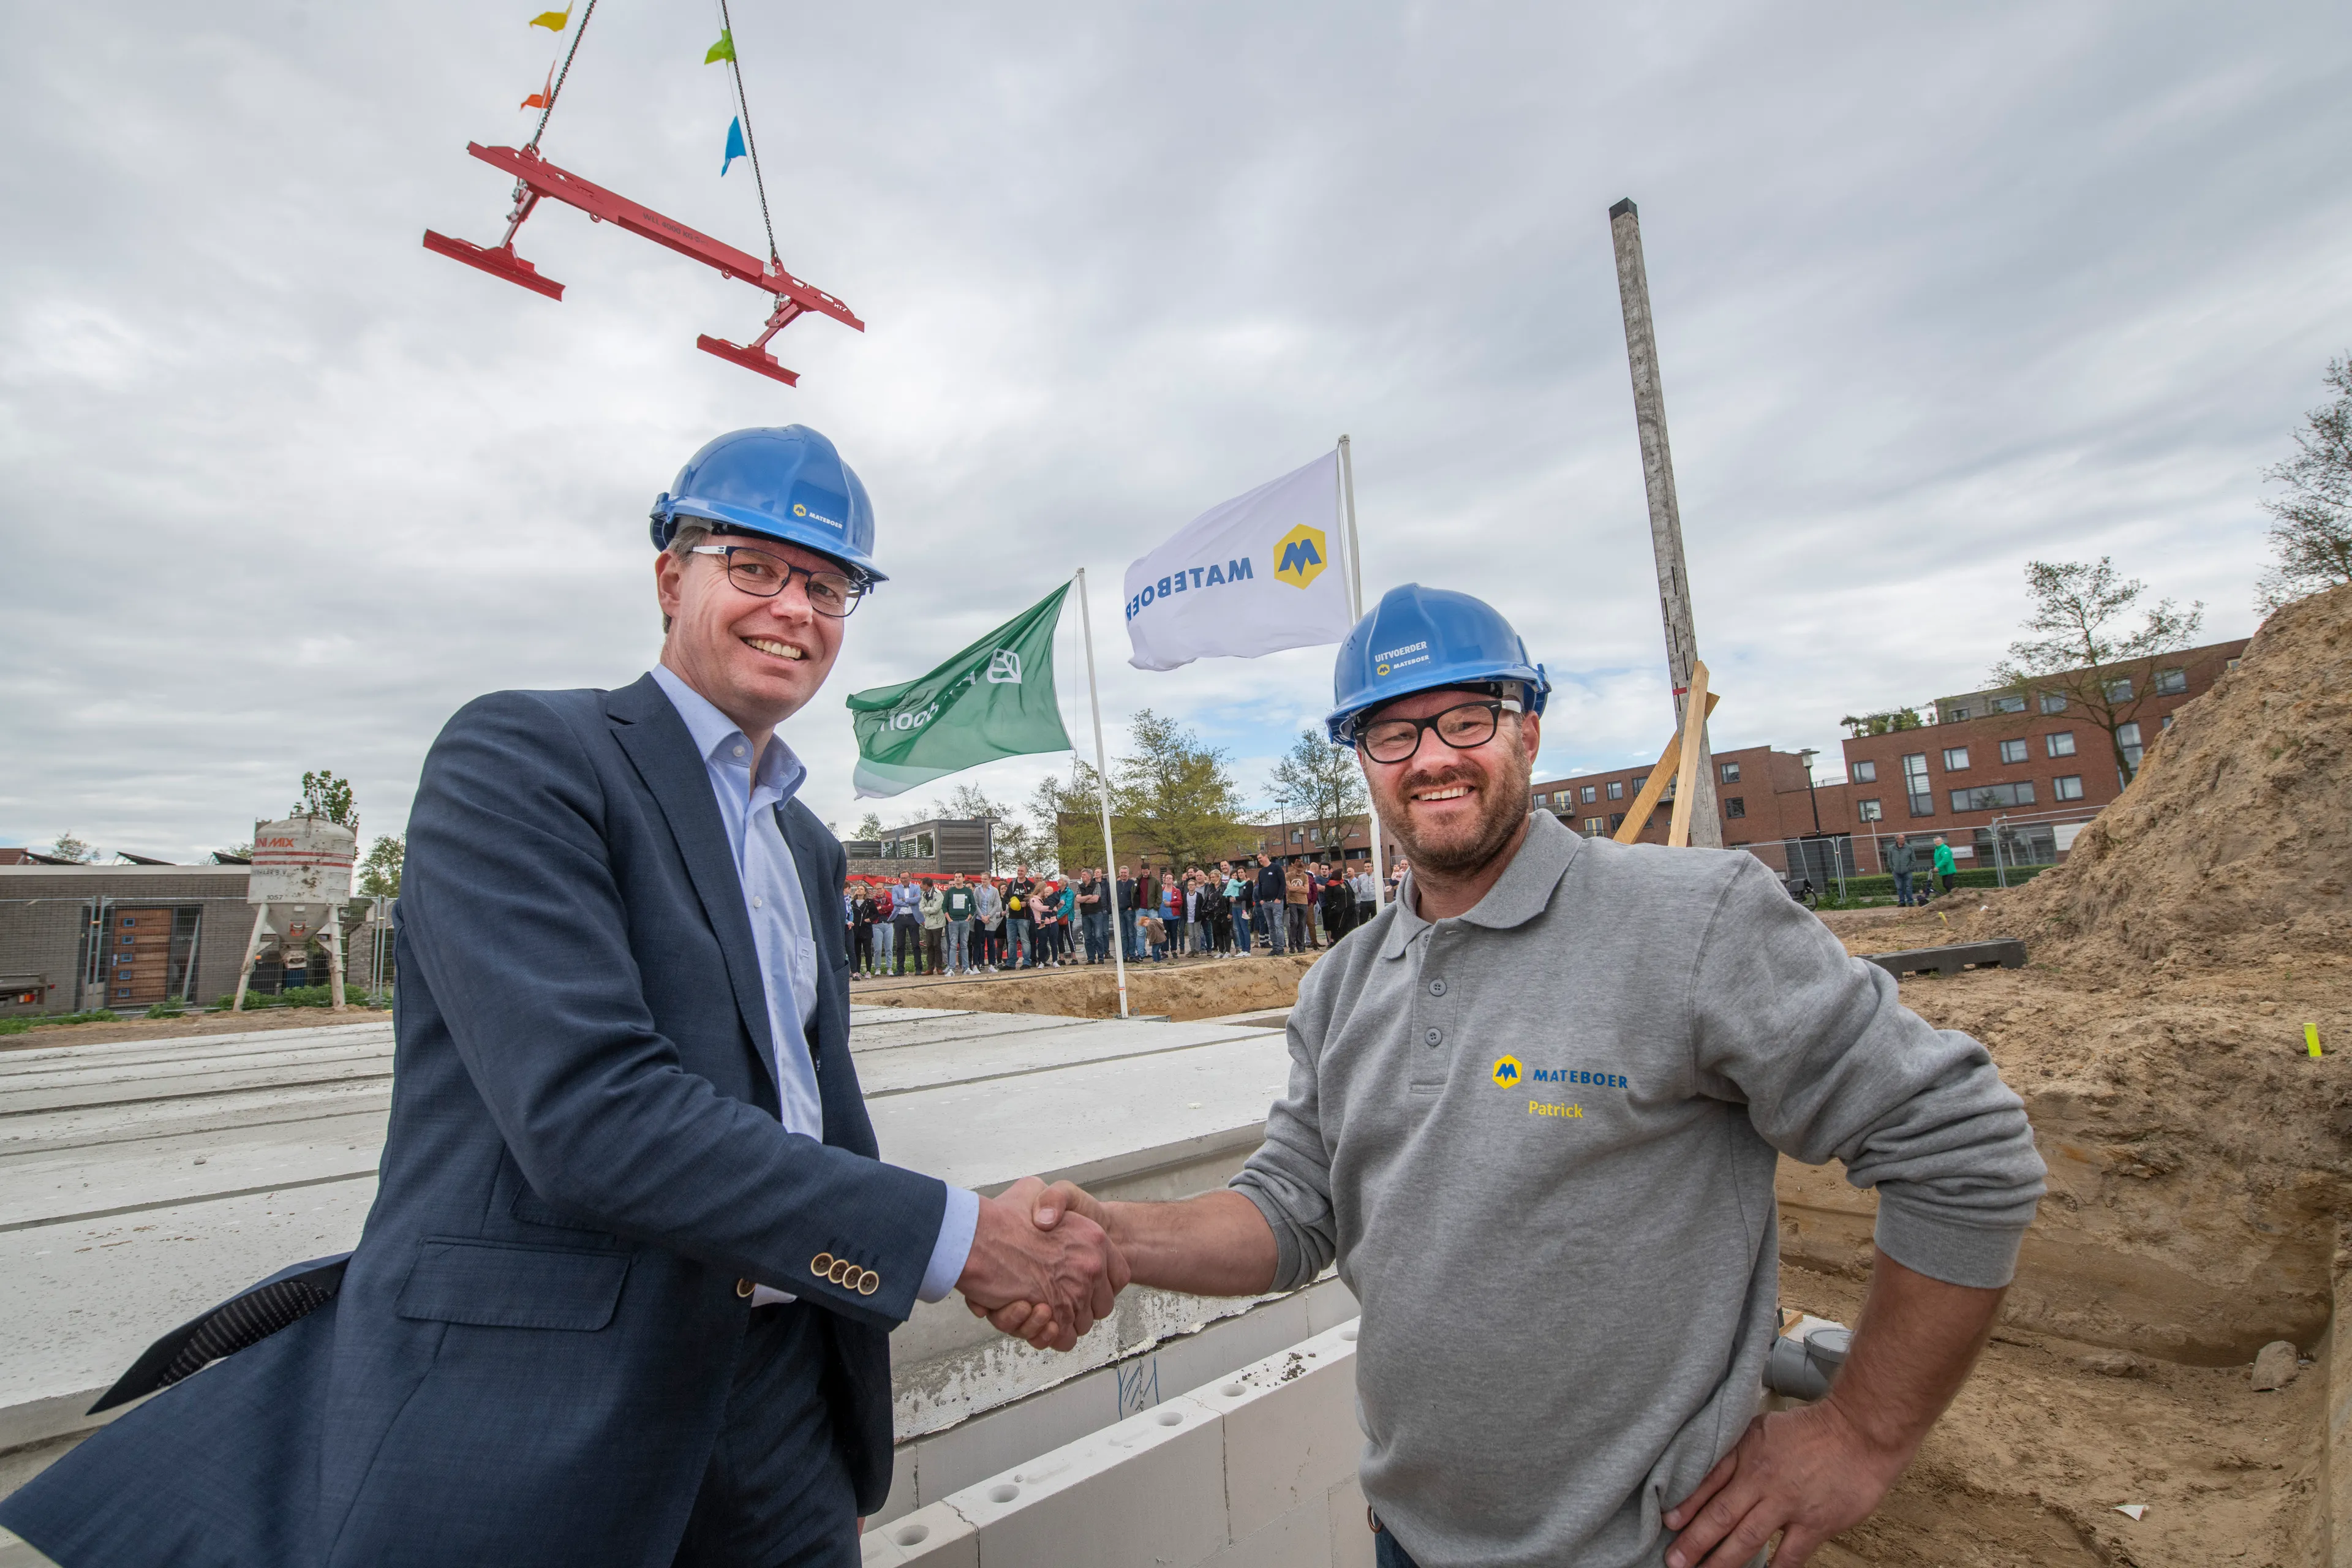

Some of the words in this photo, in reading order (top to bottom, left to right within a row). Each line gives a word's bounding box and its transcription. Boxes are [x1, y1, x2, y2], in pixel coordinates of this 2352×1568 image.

[643, 212, 660, 226] WLL
[662, 221, 681, 235] 4000
[683, 230, 693, 240] KG
[809, 511, 843, 529] MATEBOER
[1374, 641, 1427, 663] UITVOERDER
[1393, 655, 1430, 669] MATEBOER
[254, 837, 268, 848] INI
[268, 837, 295, 848] MIX
[1532, 1069, 1629, 1089] MATEBOER
[1528, 1101, 1583, 1118] Patrick
